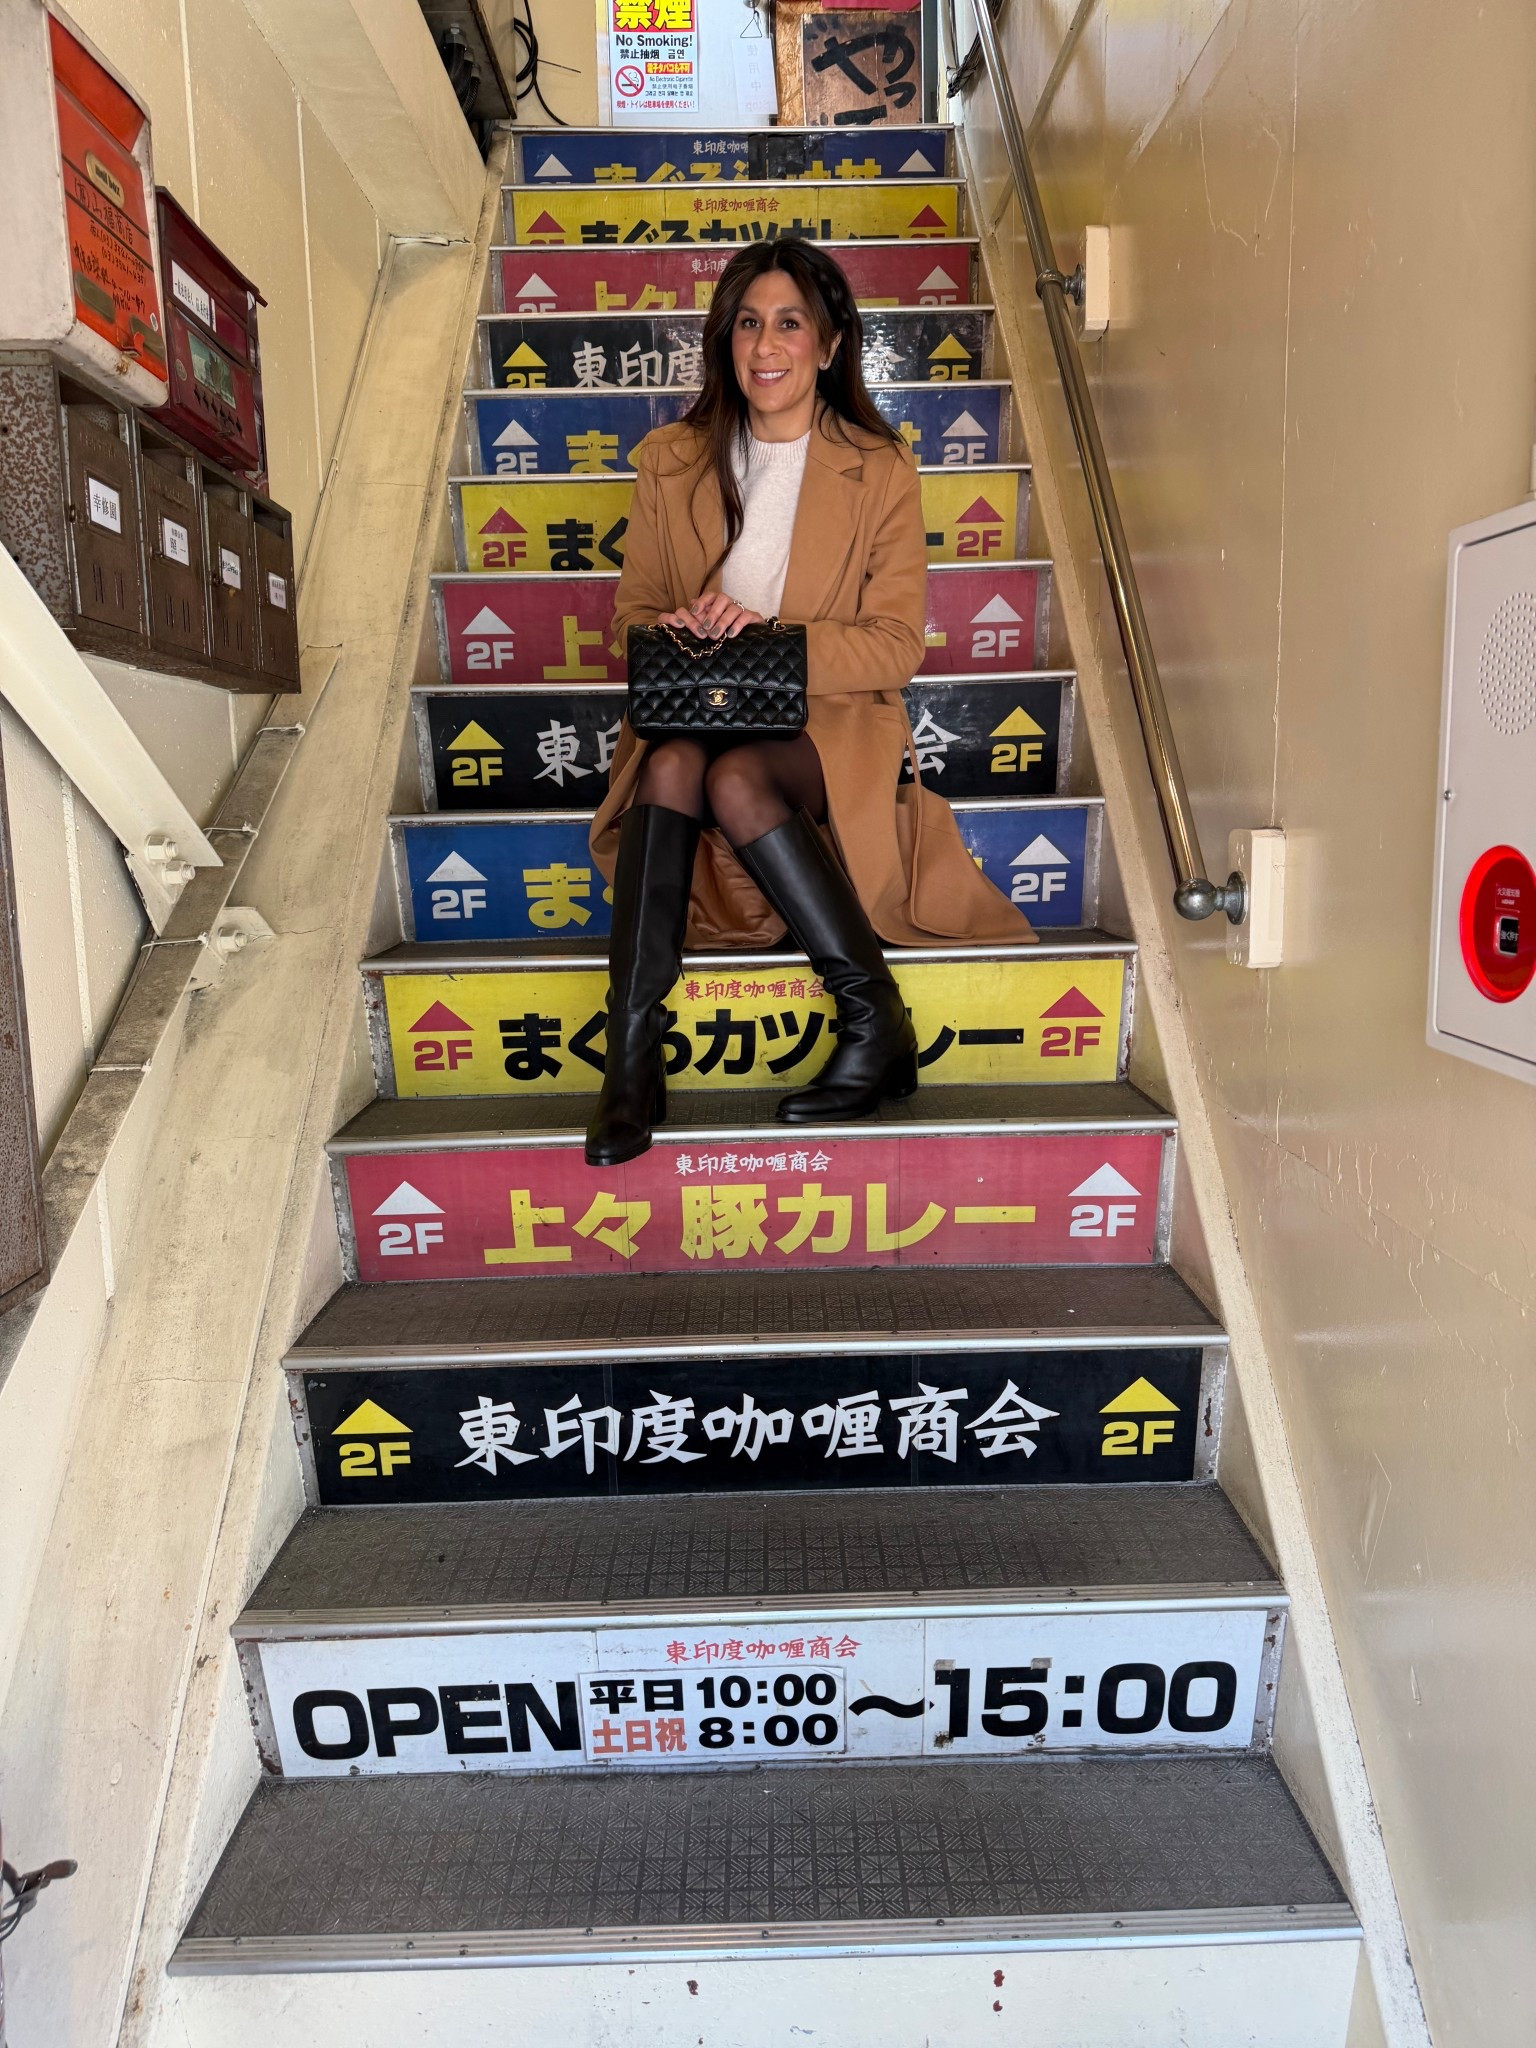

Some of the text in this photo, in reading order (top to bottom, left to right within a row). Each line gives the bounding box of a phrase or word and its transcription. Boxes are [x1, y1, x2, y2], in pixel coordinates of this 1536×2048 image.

[615, 0, 692, 30] 禁煙
[615, 34, 692, 48] No Smoking!
[620, 49, 660, 59] 禁止抽烟
[668, 49, 685, 59] 금연
[693, 197, 780, 212] 東印度咖喱商会
[506, 373, 547, 388] 2F
[930, 364, 970, 381] 2F
[496, 452, 540, 475] 2F
[943, 443, 986, 465] 2F
[482, 541, 527, 567] 2F
[956, 529, 1002, 557] 2F
[466, 641, 514, 670] 2F
[971, 629, 1020, 658] 2F
[451, 756, 503, 786] 2F
[991, 742, 1043, 773] 2F
[1010, 871, 1067, 903] 2F
[431, 888, 487, 919] 2F
[684, 977, 825, 1001] 東印度咖喱商会
[413, 1039, 473, 1072] 2F
[1039, 1025, 1101, 1058] 2F
[674, 1150, 833, 1176] 東印度咖喱商会
[484, 1183, 1036, 1265] 上々 豚カレー
[1069, 1204, 1137, 1238] 2F
[378, 1222, 445, 1256] 2F
[454, 1378, 1060, 1477] 東印度咖喱商会
[1101, 1420, 1175, 1456] 2F
[338, 1441, 412, 1478] 2F
[665, 1634, 862, 1664] 東印度咖喱商会
[589, 1673, 837, 1714] 平日 10:00
[292, 1681, 582, 1760] OPEN
[592, 1713, 838, 1754] 土日祝 8:00
